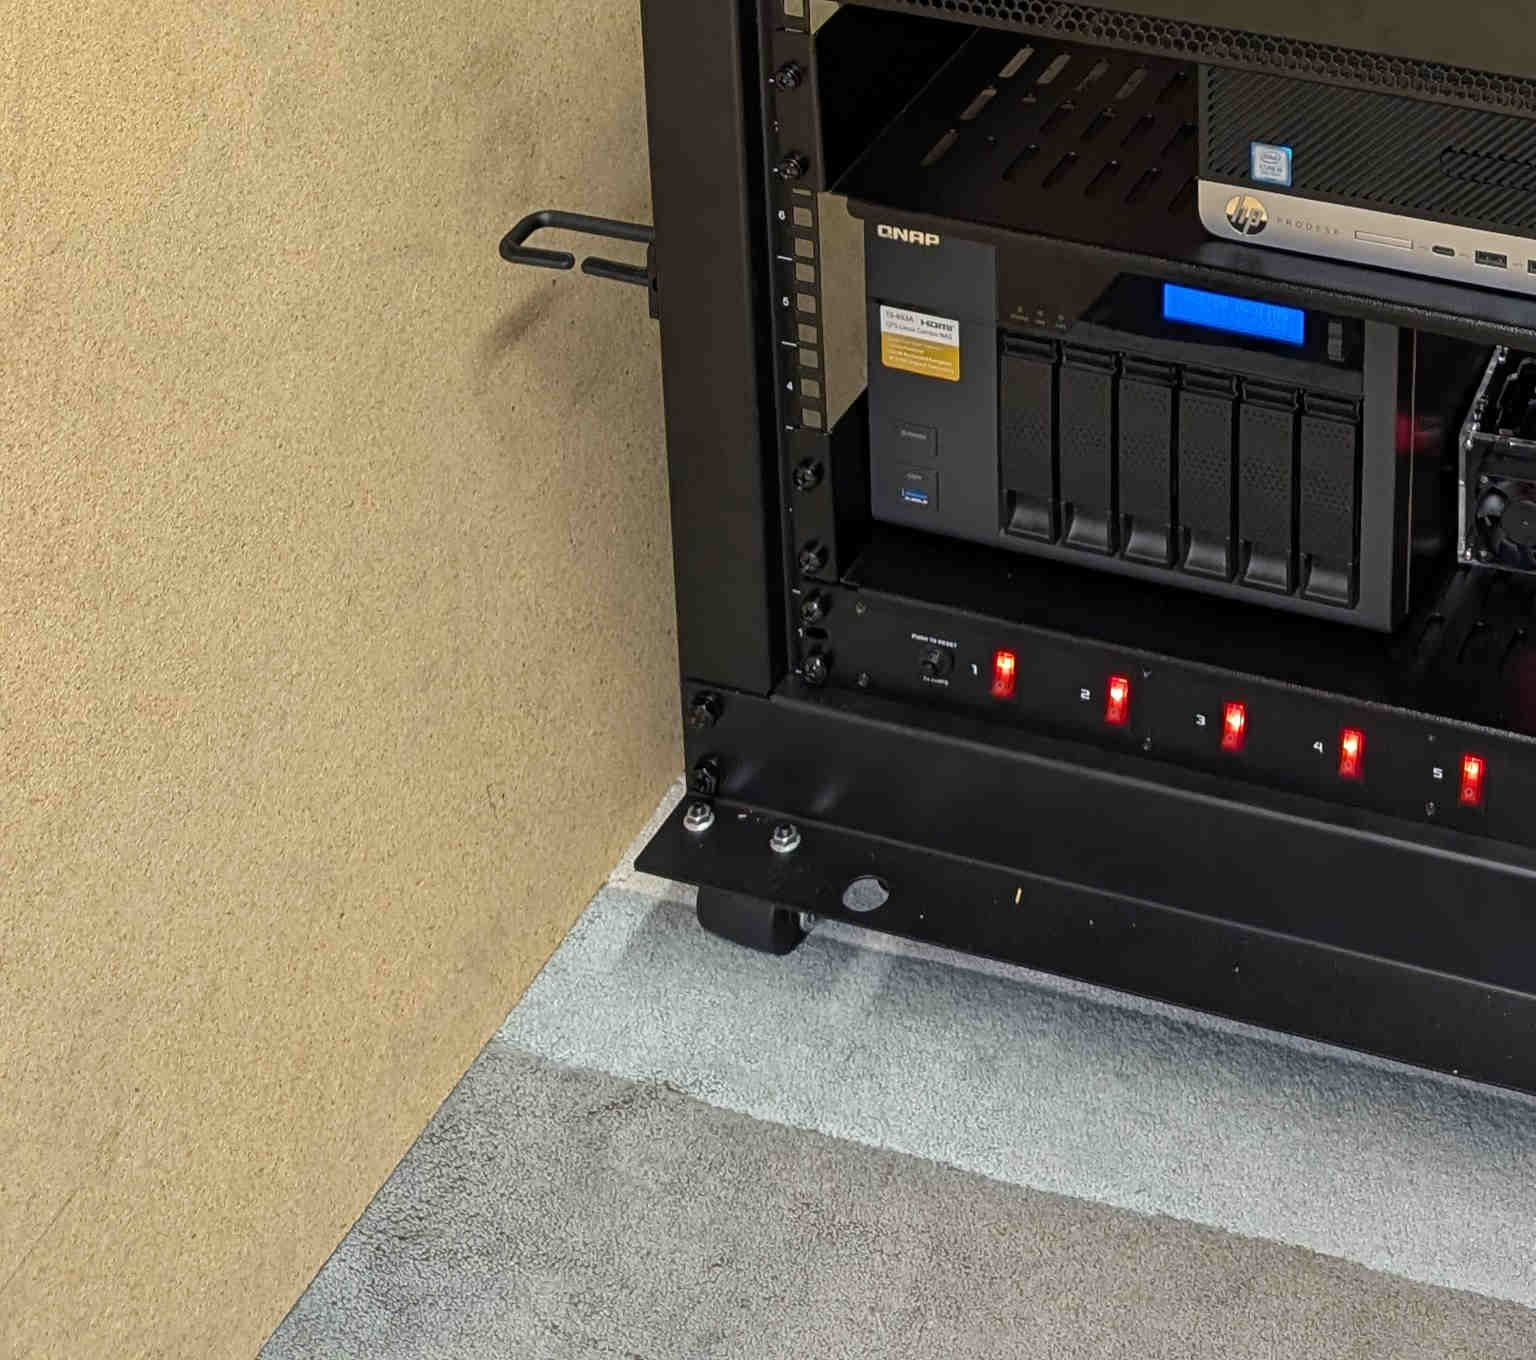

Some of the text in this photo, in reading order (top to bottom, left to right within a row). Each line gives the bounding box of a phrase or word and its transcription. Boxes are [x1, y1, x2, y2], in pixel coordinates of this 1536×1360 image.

[877, 223, 942, 247] QNAP
[1080, 687, 1091, 701] 2
[1195, 713, 1206, 727] 3
[1312, 740, 1324, 754] 4
[1432, 766, 1444, 780] 5
